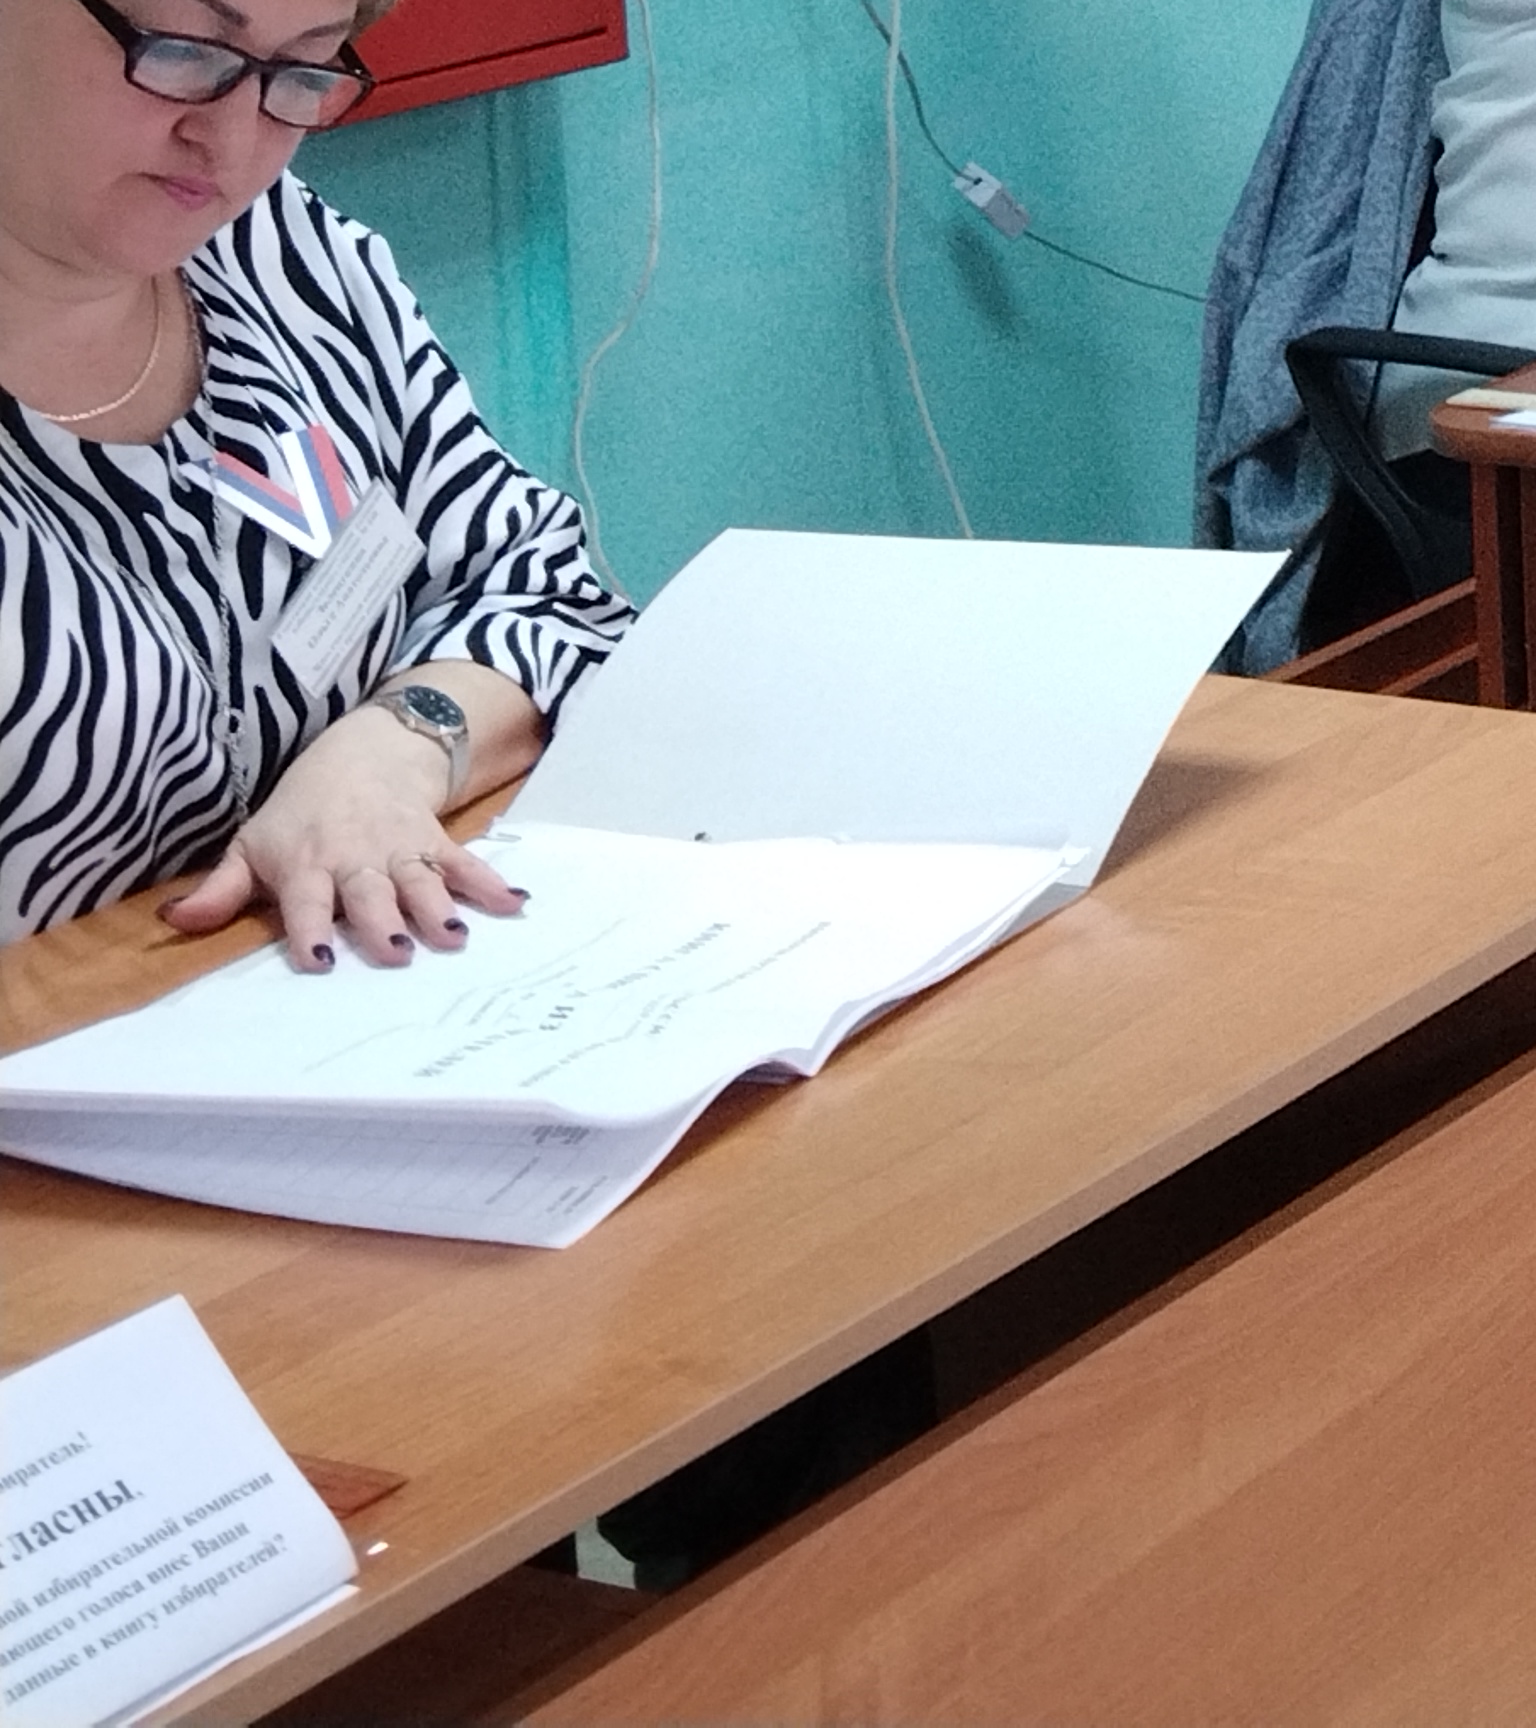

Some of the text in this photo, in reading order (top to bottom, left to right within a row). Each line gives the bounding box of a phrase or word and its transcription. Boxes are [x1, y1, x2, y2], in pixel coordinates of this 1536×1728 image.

[33, 1517, 182, 1607] избирательной
[182, 1472, 274, 1527] комиссии
[77, 1579, 146, 1622] голоса
[146, 1553, 192, 1584] внес
[191, 1522, 250, 1559] Ваши
[83, 1643, 98, 1659] в
[100, 1608, 159, 1650] книгу
[161, 1533, 288, 1616] избирателей?
